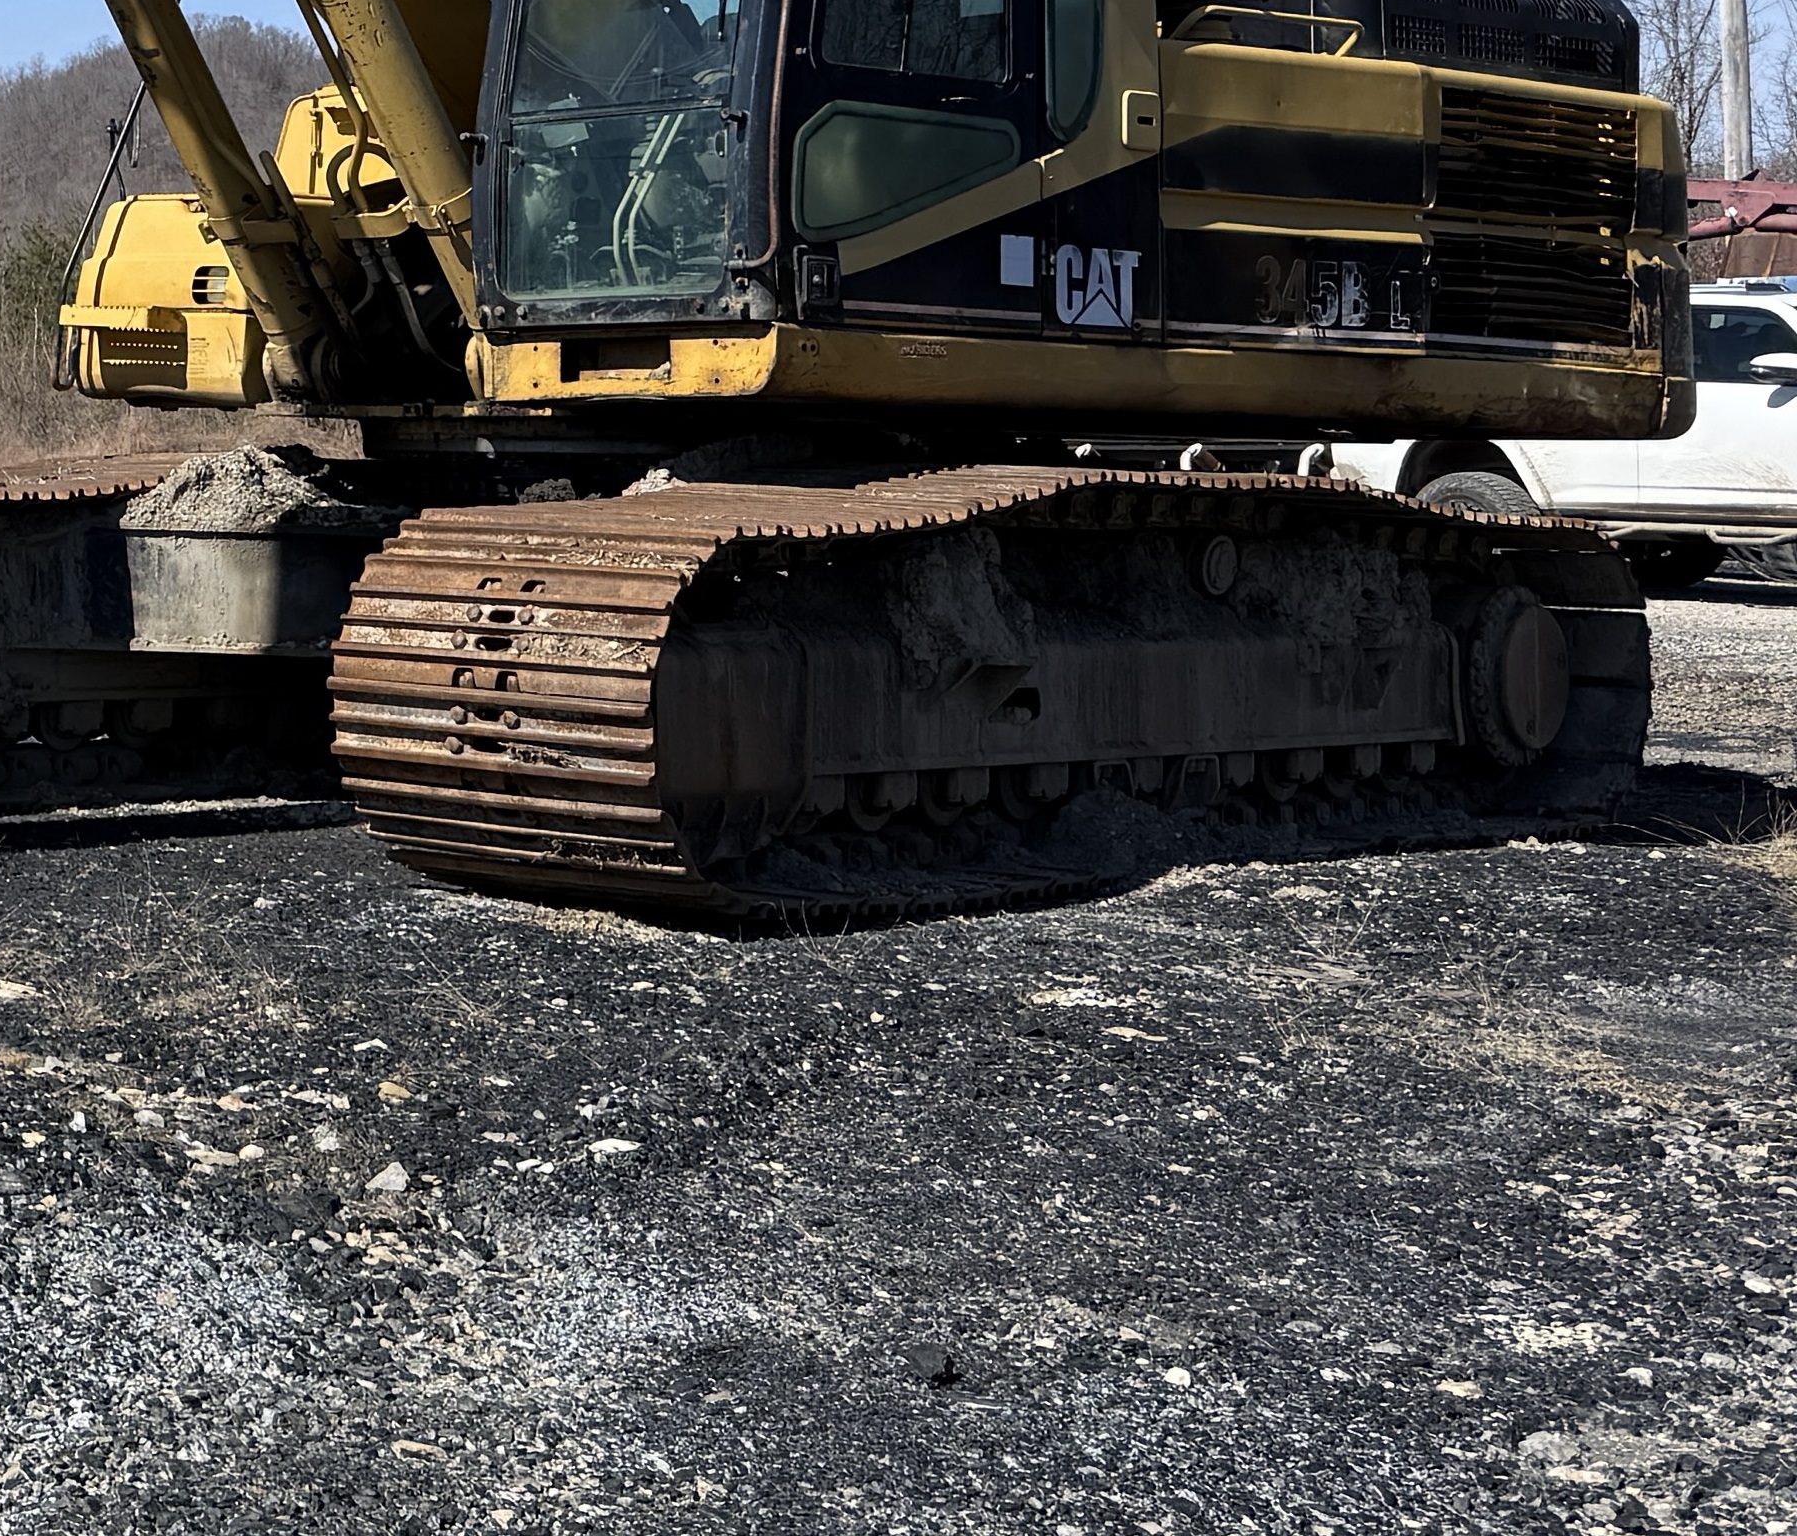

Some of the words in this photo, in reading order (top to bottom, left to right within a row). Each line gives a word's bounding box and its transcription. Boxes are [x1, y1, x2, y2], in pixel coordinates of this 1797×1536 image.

[1056, 244, 1140, 328] CAT
[1255, 255, 1371, 327] 345B
[1390, 280, 1411, 329] L
